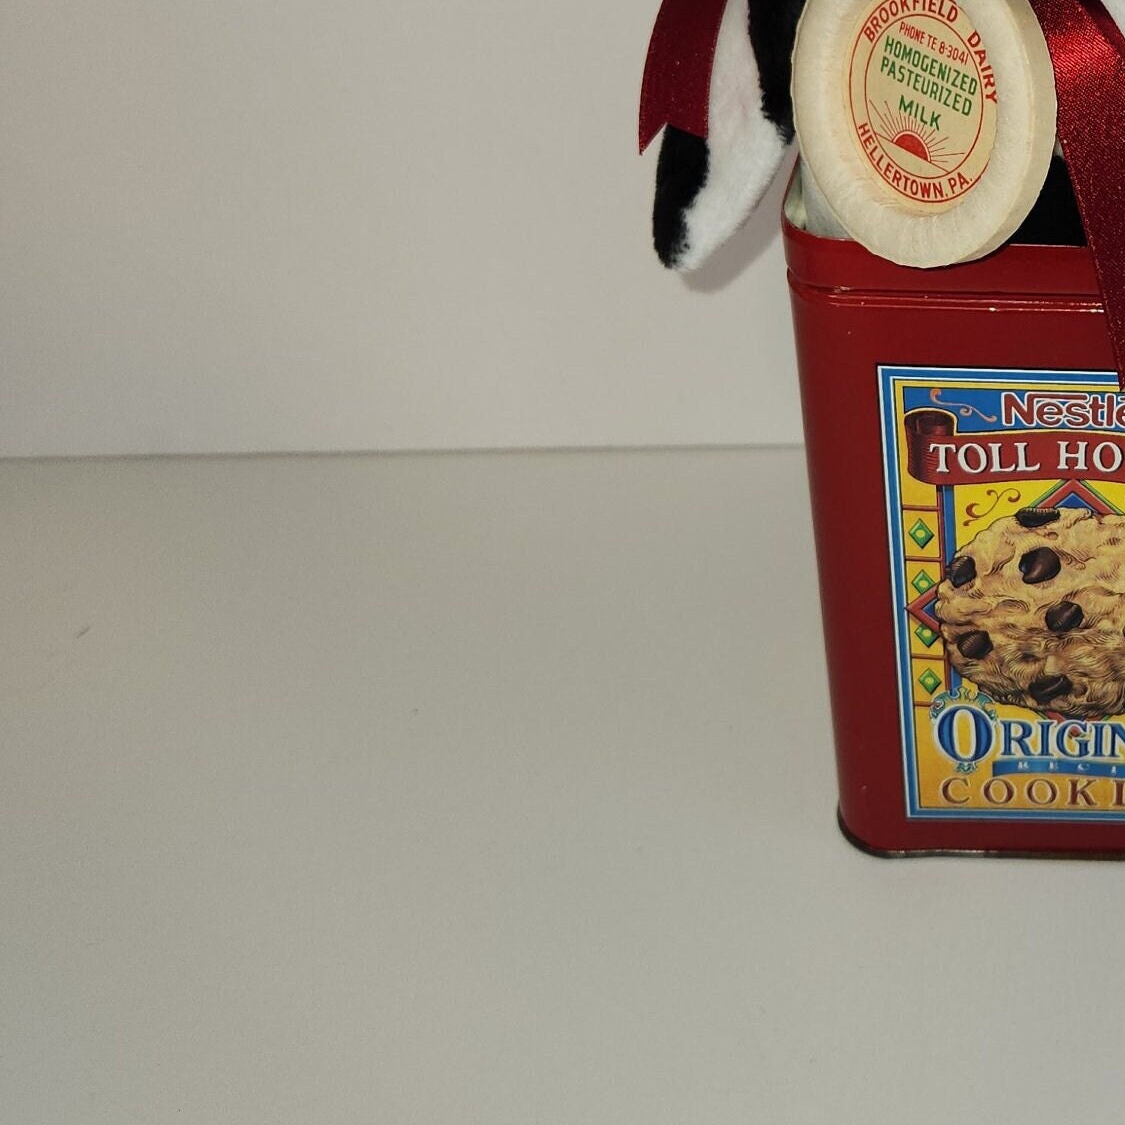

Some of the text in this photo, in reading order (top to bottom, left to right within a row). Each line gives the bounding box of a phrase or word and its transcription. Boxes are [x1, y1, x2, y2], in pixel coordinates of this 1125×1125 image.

[883, 35, 978, 96] HOMOGENIZED
[898, 21, 969, 66] PHONE TE 8-3041
[880, 55, 972, 116] PASTEURIZED
[966, 29, 998, 104] DAIRY
[898, 94, 941, 132] MILK
[947, 171, 974, 194] PA.
[929, 441, 1041, 474] TOLL
